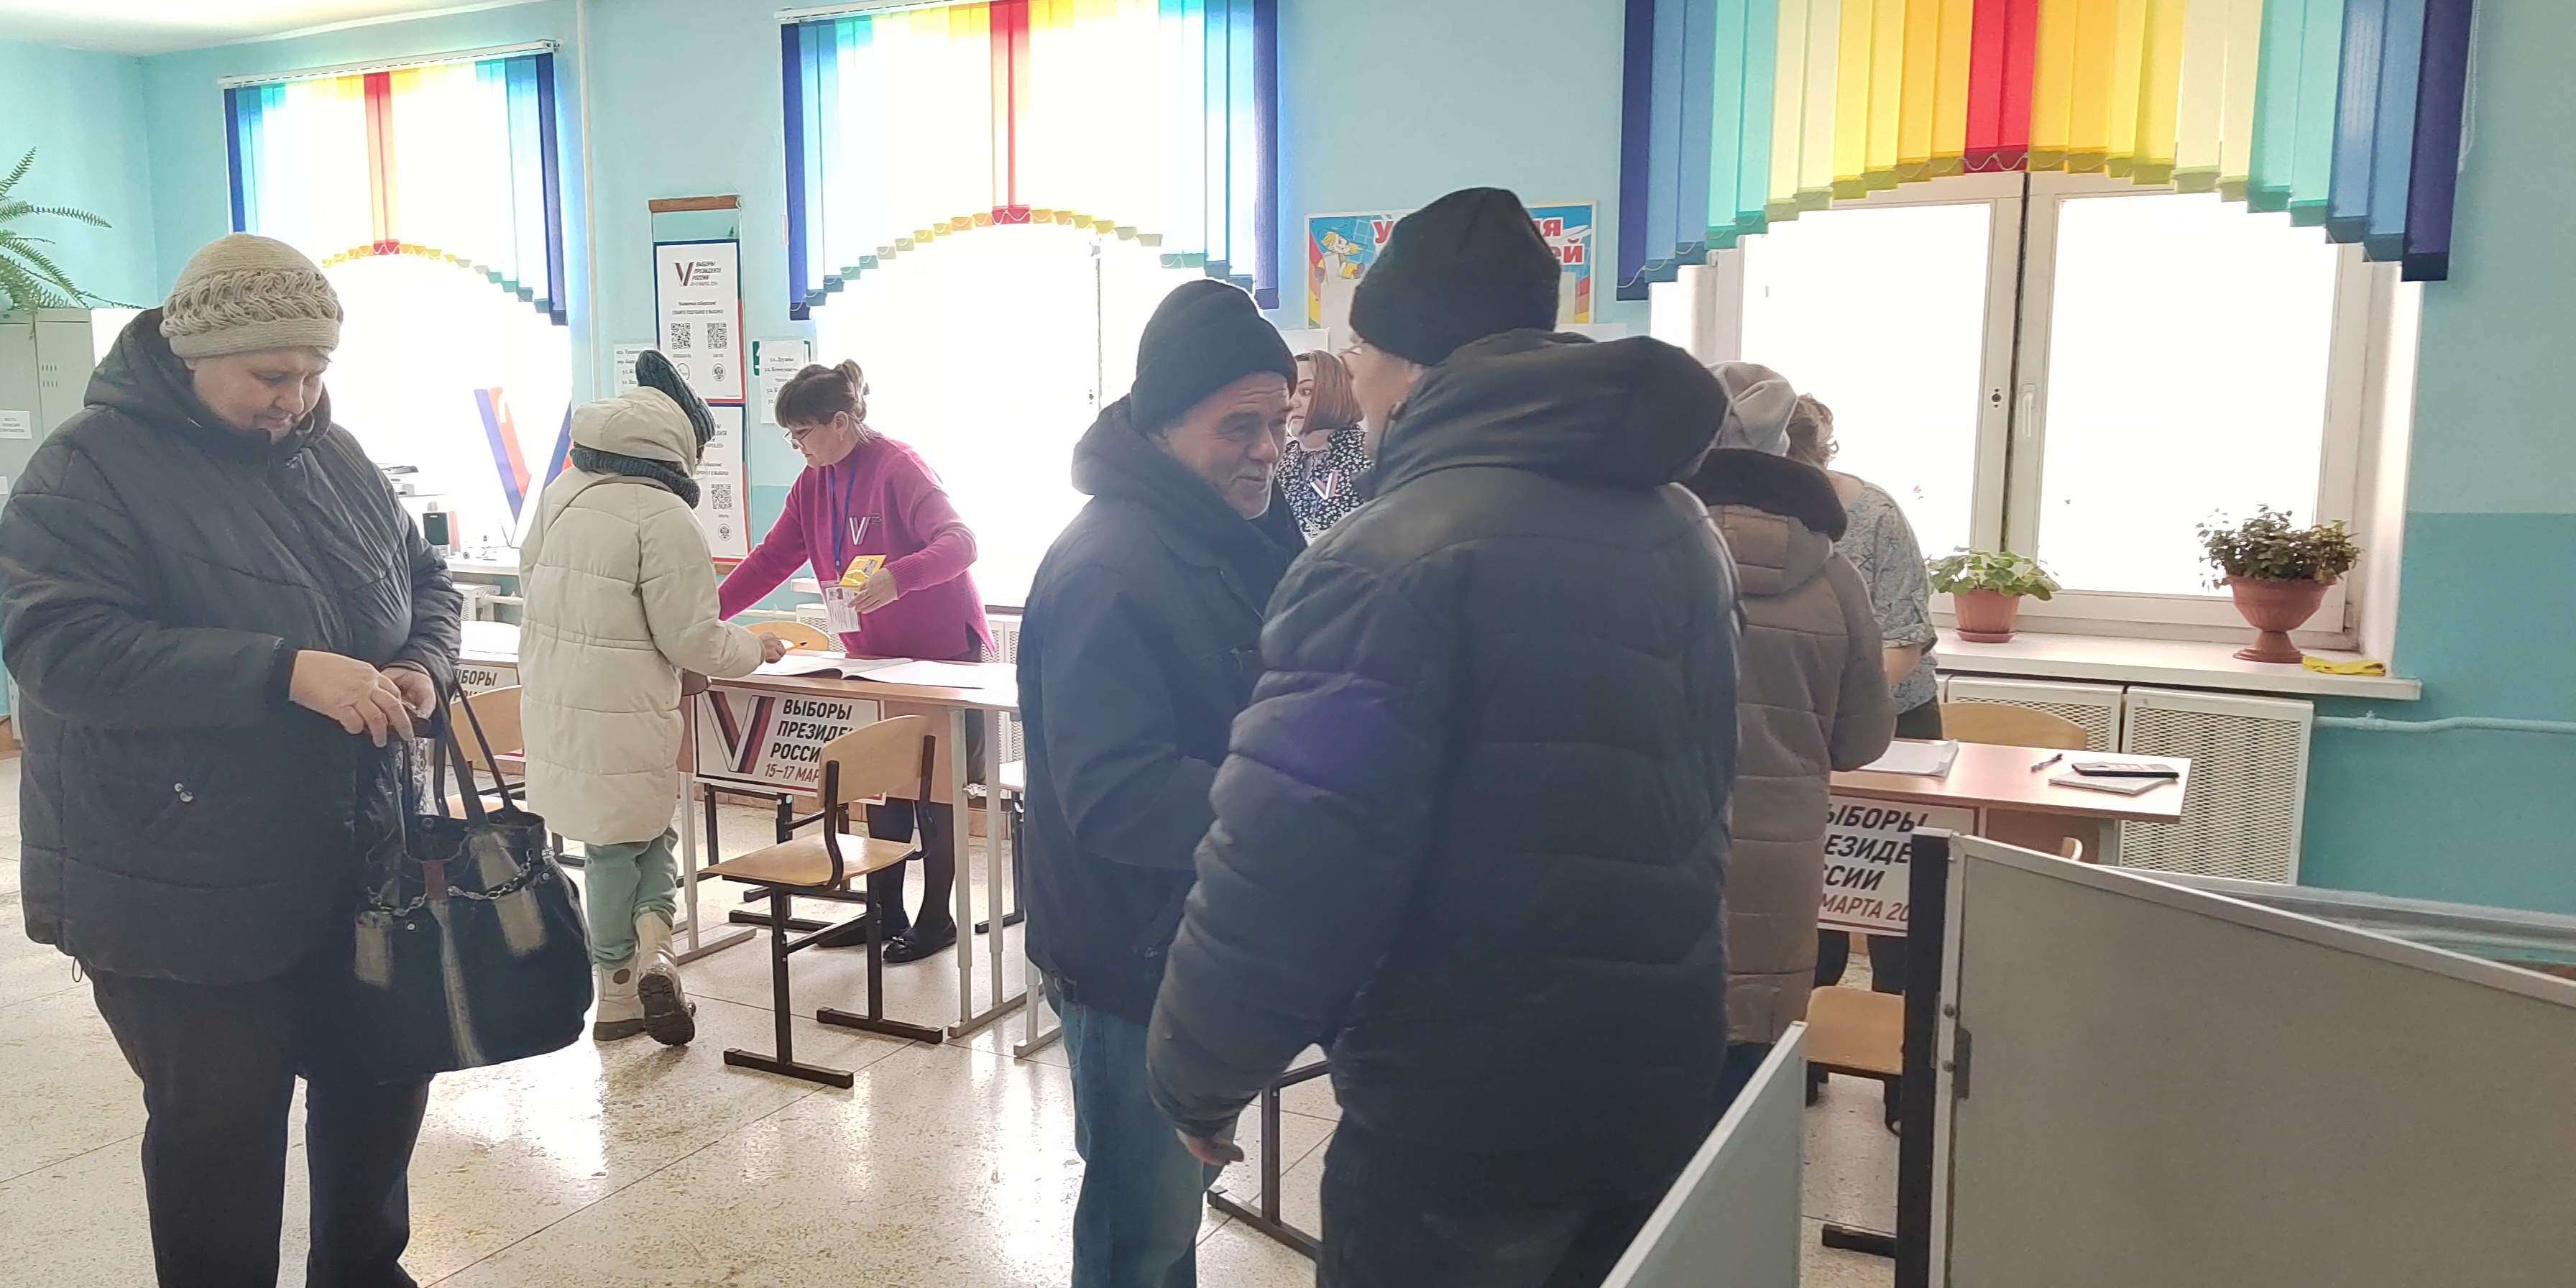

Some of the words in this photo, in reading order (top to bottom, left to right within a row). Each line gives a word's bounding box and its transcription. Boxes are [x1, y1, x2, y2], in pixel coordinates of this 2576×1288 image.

[783, 699, 853, 721] ВЫБОРЫ
[776, 720, 854, 743] ПРЕЗИДЕ
[770, 742, 822, 763] РОССИ
[794, 766, 819, 783] МАР
[1826, 803, 1928, 833] ЫБОРЫ
[1824, 834, 1912, 865] ЕЗИДЕ
[1885, 901, 1909, 923] 20
